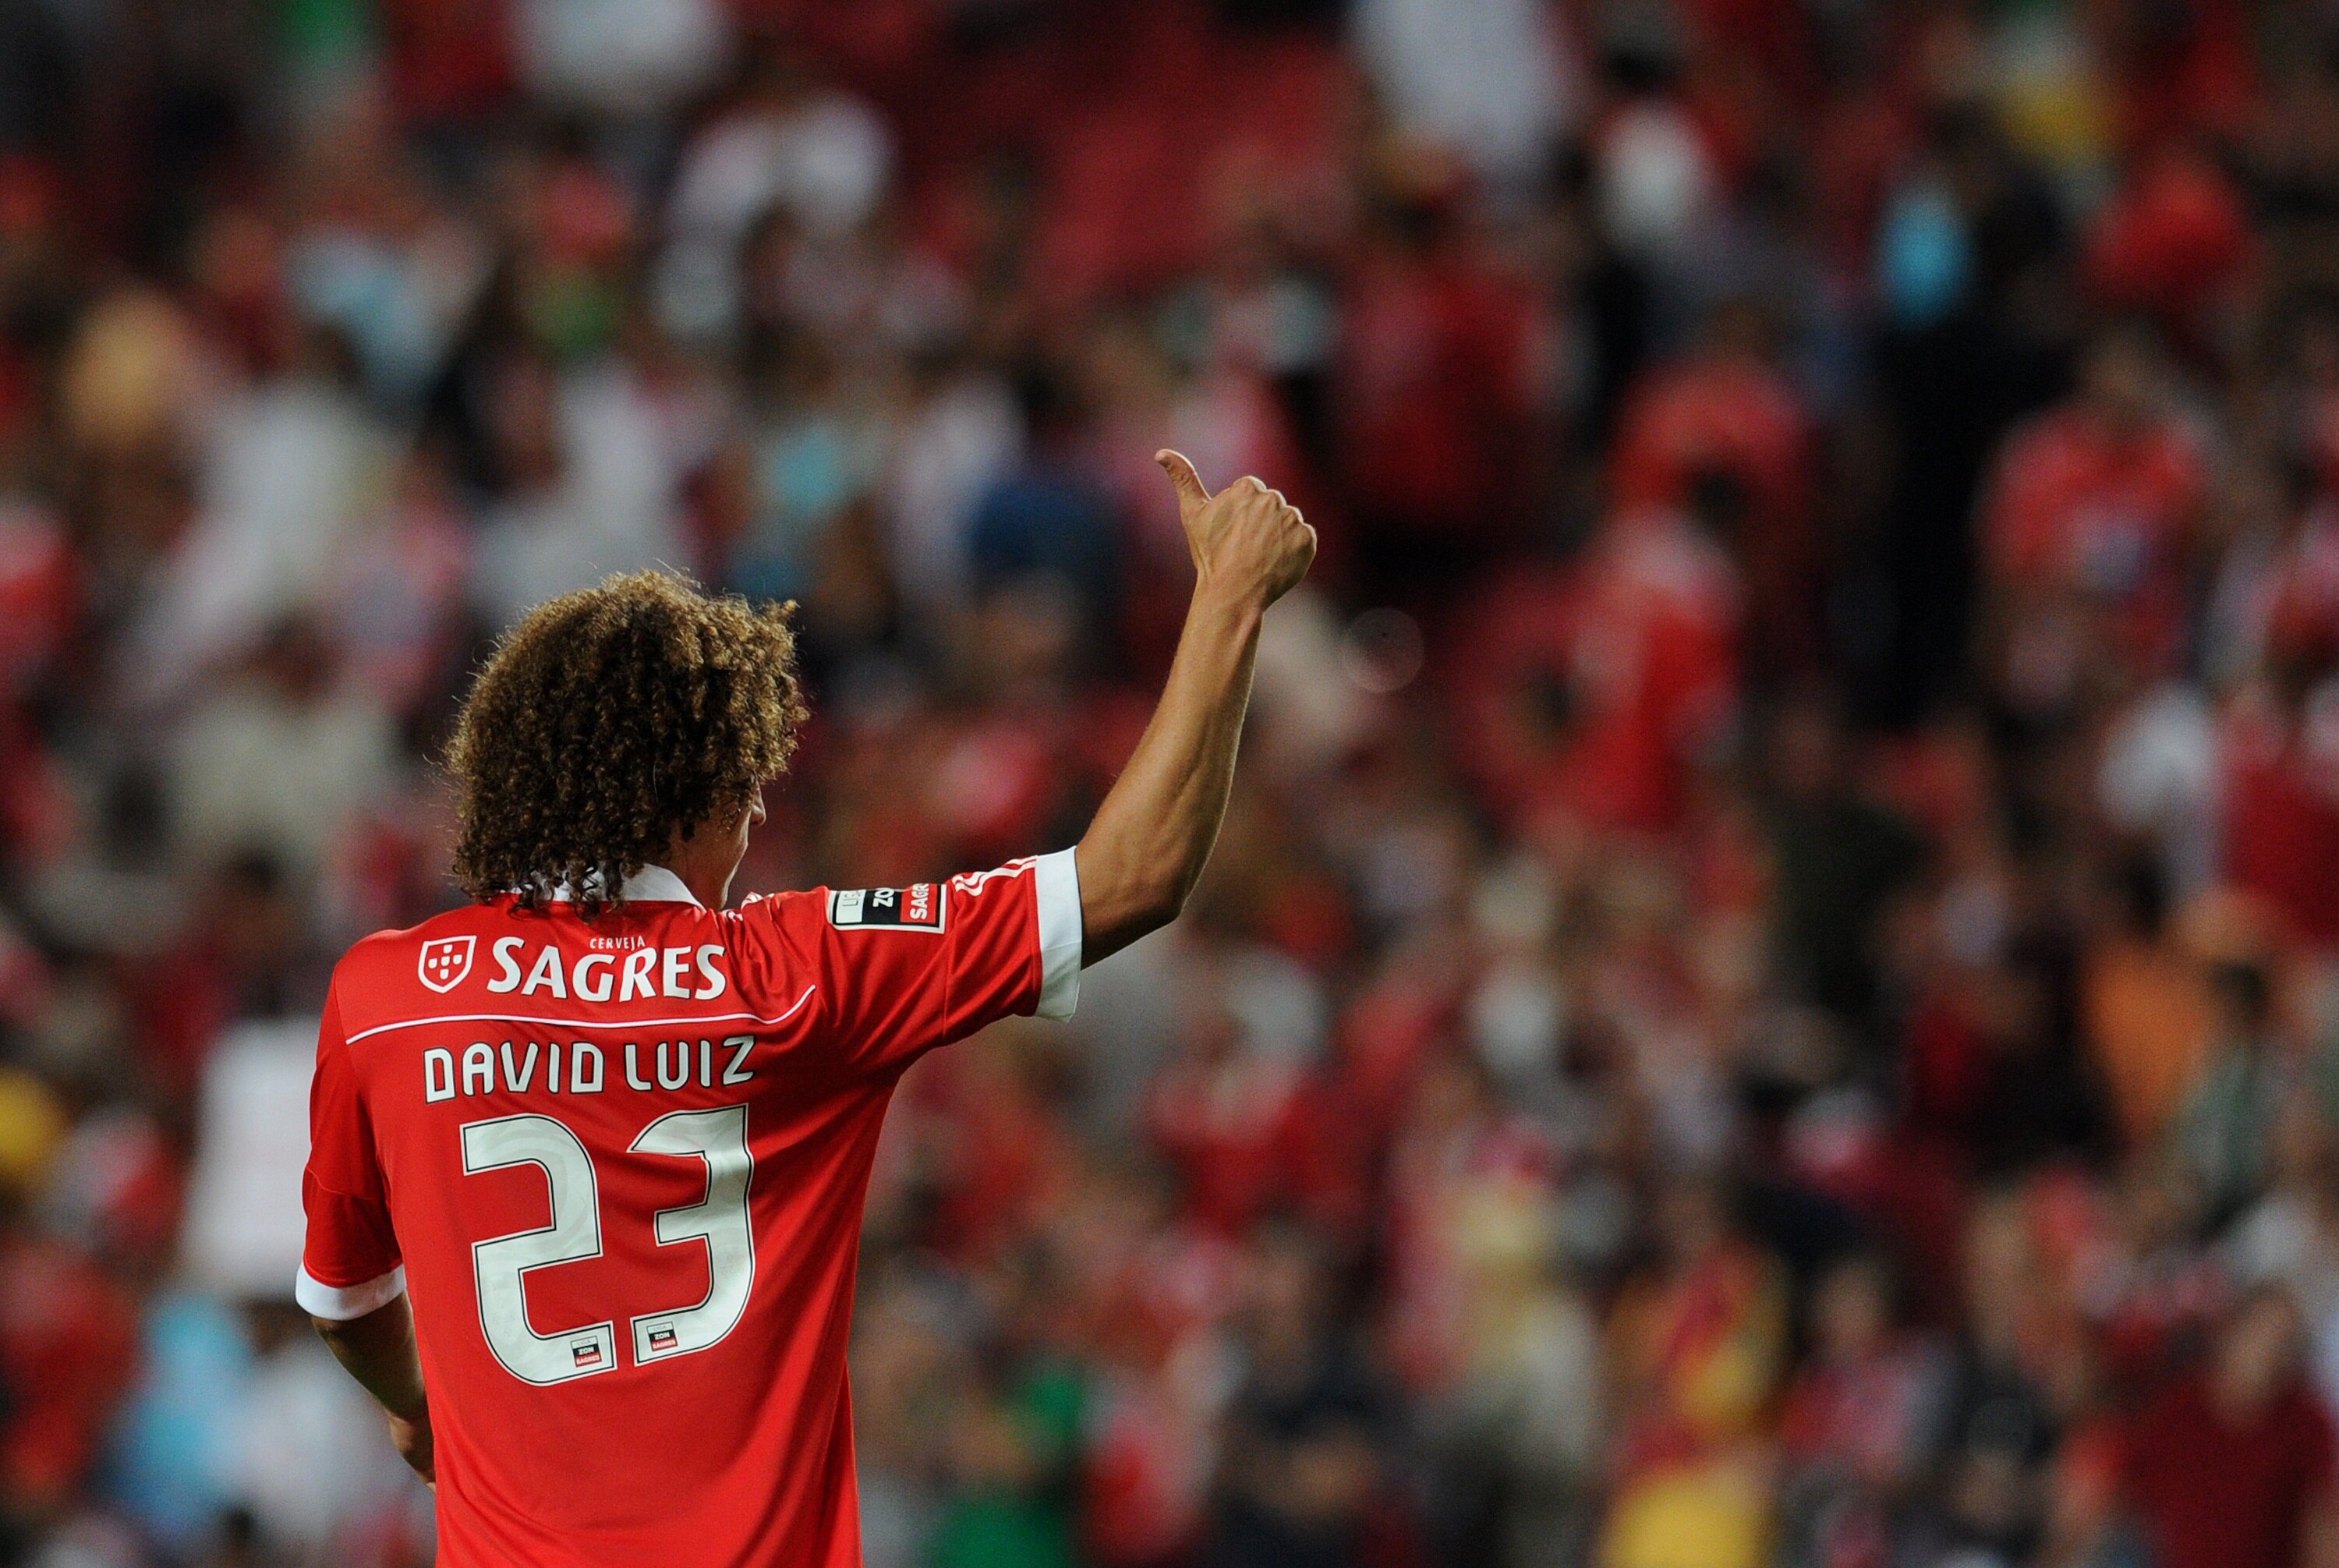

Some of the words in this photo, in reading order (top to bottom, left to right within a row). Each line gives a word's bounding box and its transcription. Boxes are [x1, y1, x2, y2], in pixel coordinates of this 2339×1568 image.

[487, 936, 727, 1002] SAGRES
[589, 935, 646, 951] CERVEJA
[423, 1041, 604, 1104] DAVID
[625, 1035, 755, 1091] LUIZ
[459, 1103, 755, 1387] 23
